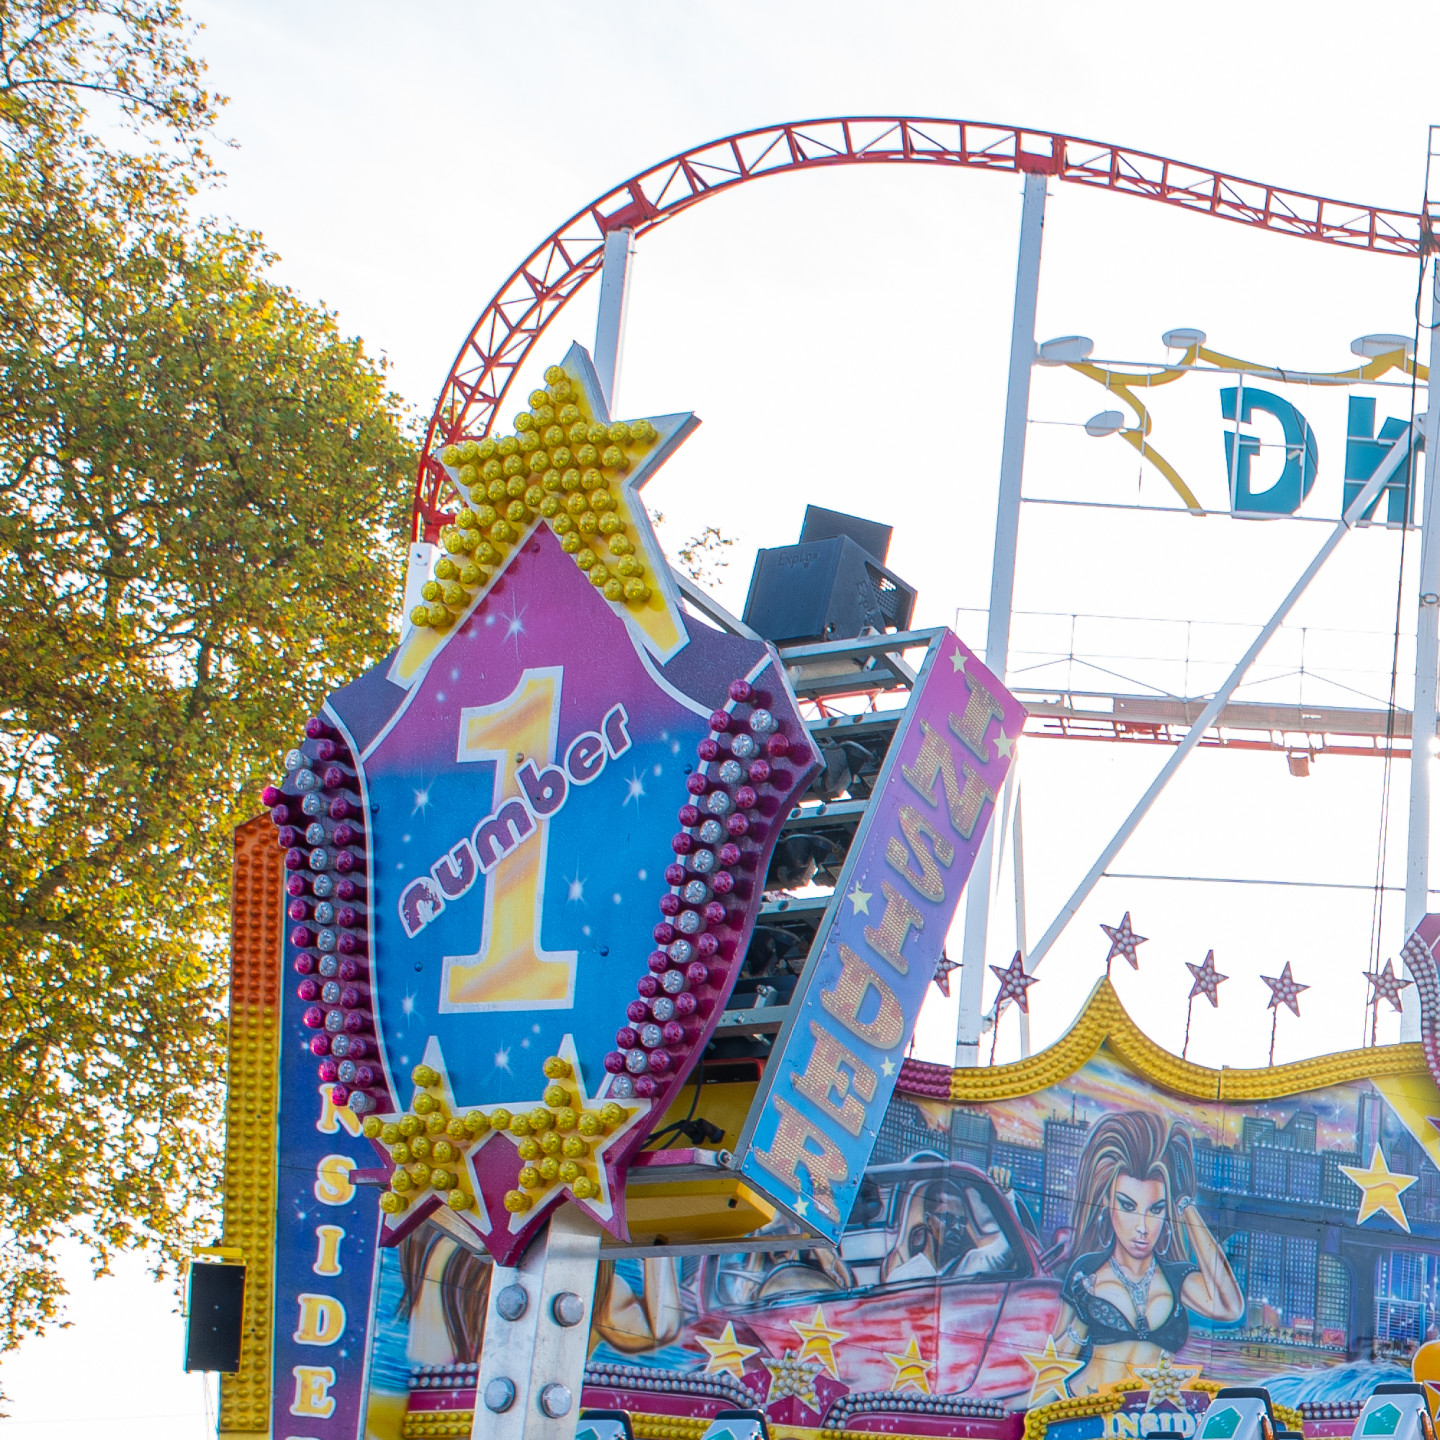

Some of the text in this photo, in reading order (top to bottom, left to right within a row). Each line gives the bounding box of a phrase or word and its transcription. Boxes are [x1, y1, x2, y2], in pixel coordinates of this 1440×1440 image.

[398, 703, 632, 938] number
[439, 666, 577, 1013] 1
[752, 670, 1006, 1223] INSIDER
[1102, 1412, 1200, 1440] INSID
